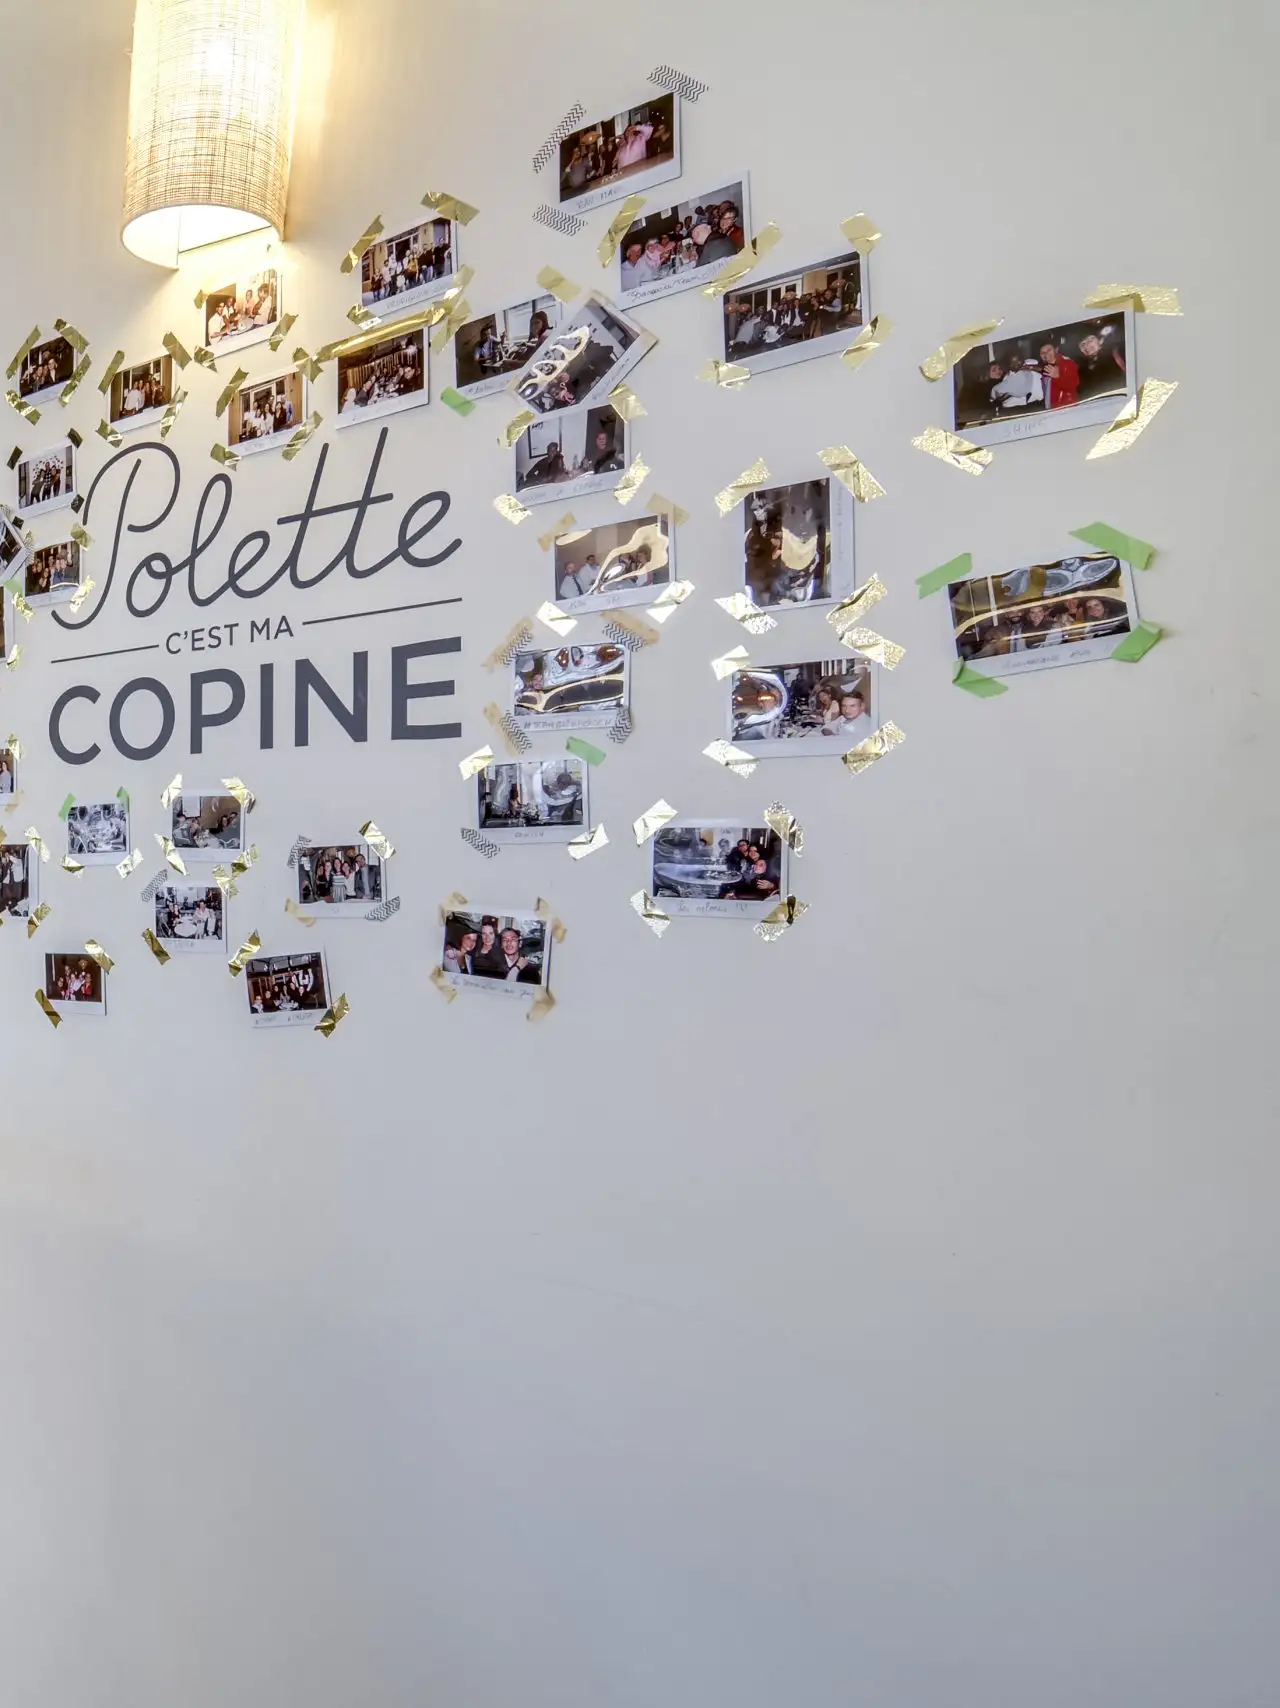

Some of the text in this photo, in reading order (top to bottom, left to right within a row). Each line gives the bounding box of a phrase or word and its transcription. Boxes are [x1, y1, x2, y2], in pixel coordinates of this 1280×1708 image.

[51, 427, 462, 630] Polette
[165, 615, 294, 655] C'EST MA
[49, 636, 462, 765] COPINE
